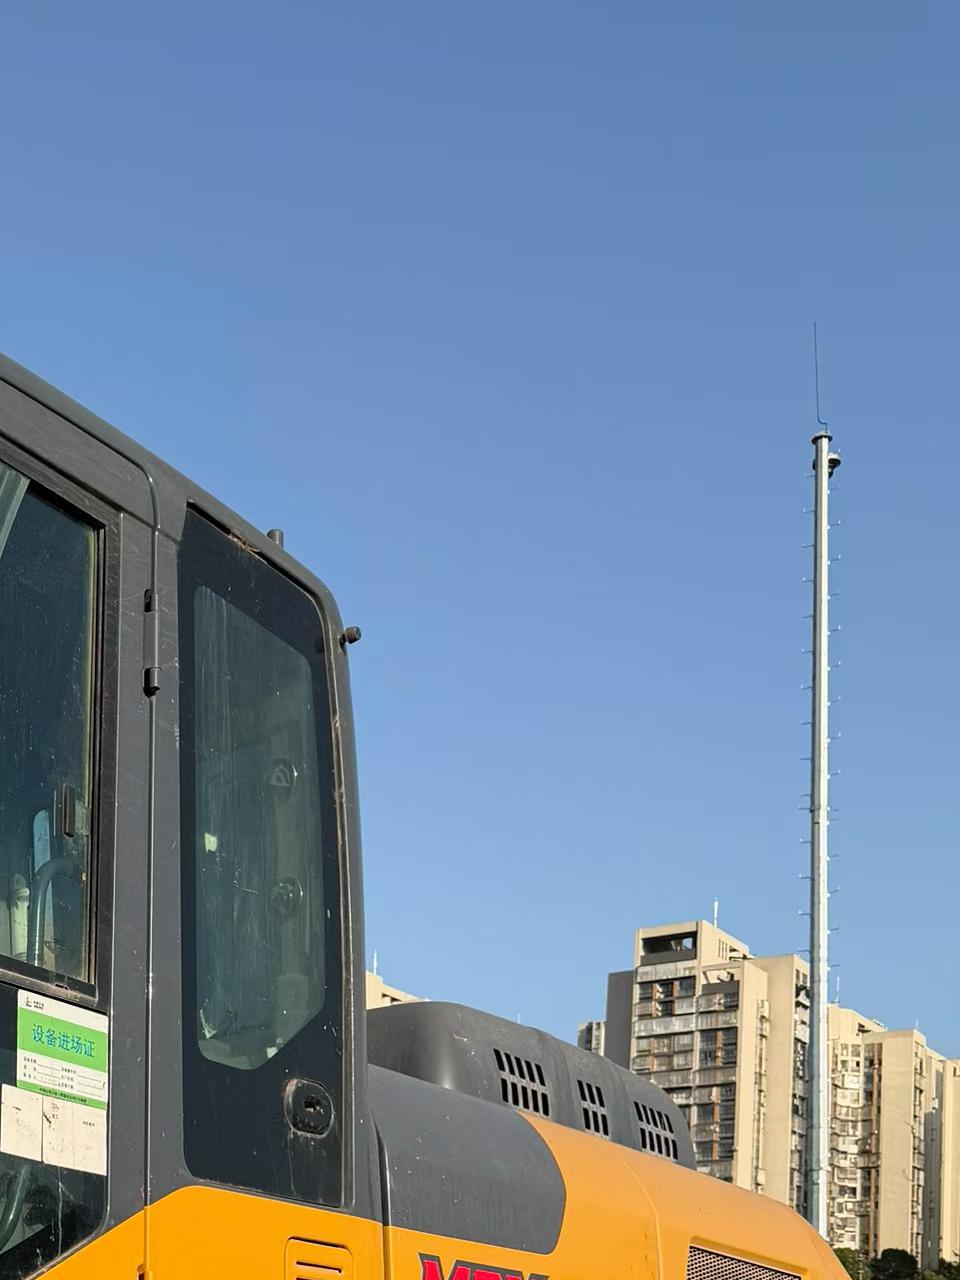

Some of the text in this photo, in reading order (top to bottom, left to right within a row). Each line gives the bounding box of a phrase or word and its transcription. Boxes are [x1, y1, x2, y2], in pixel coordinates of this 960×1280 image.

[32, 1024, 95, 1058] 设备进场证
